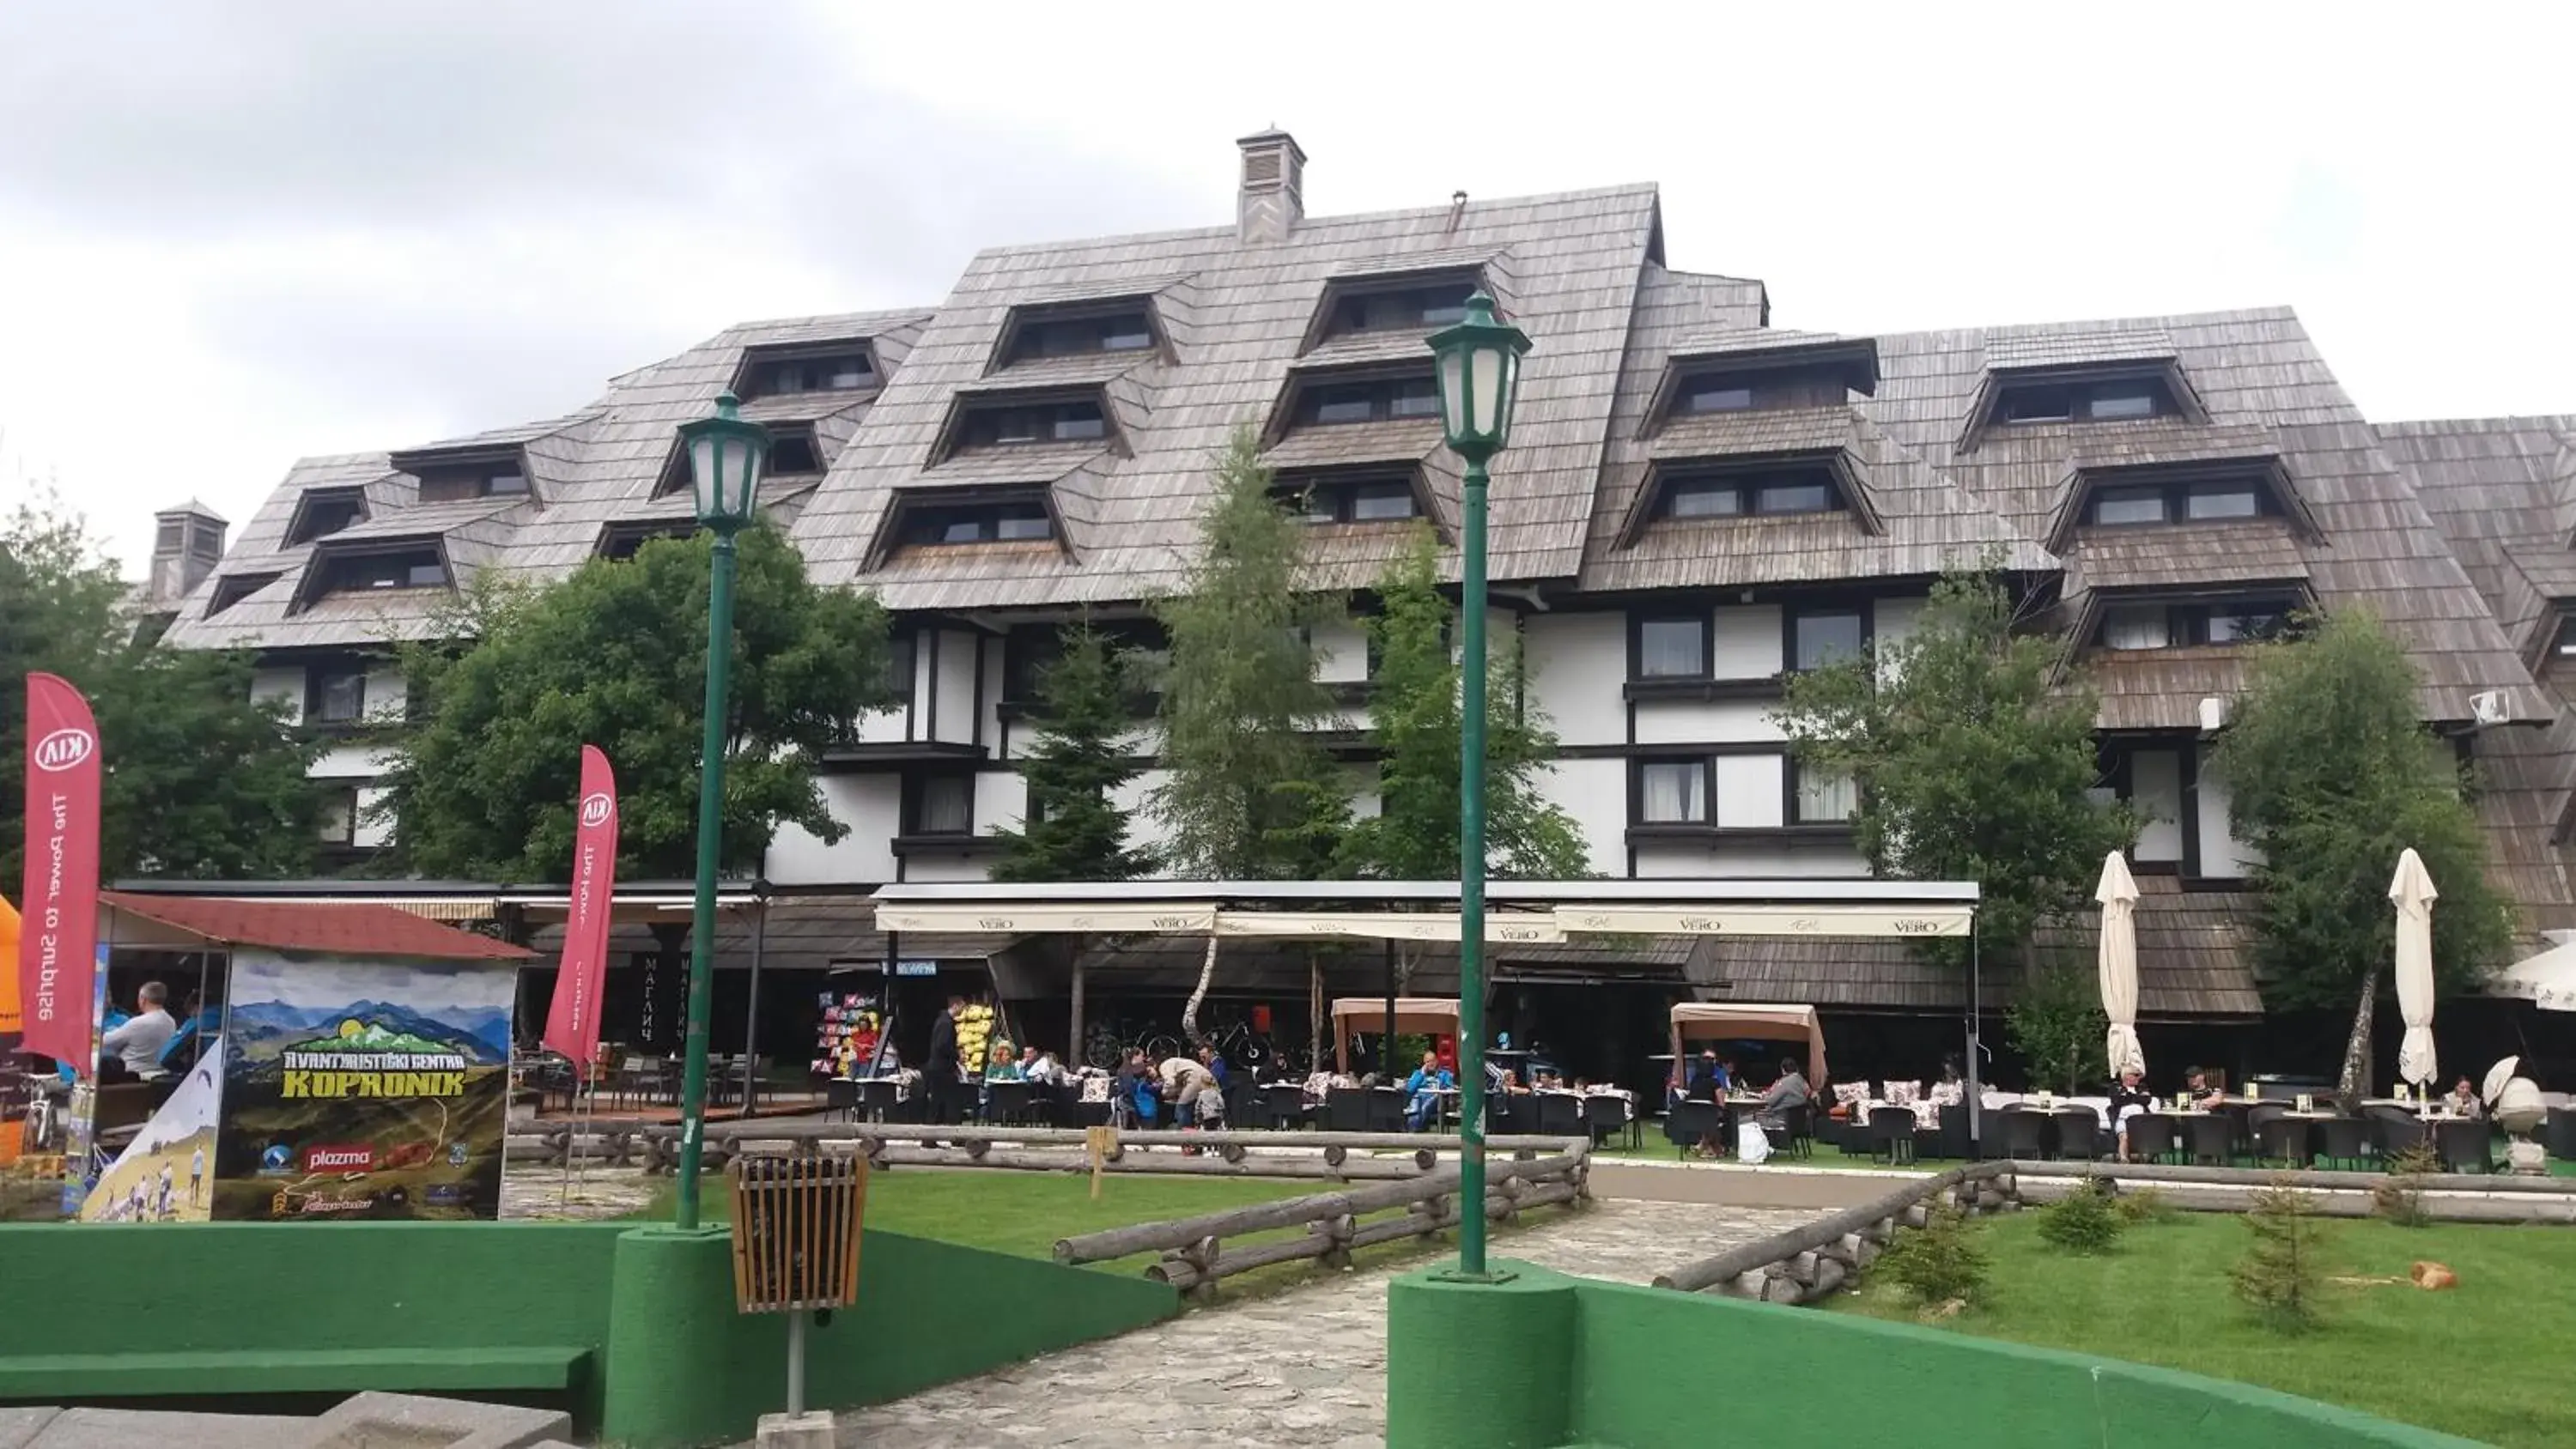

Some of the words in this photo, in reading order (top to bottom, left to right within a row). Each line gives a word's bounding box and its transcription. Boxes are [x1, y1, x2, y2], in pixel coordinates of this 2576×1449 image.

[1680, 919, 1721, 931] VERO
[1895, 921, 1938, 933] VERO
[641, 958, 657, 1041] МАГЛИЧ
[281, 1070, 465, 1098] KOPAONIK
[309, 1150, 371, 1168] plazma
